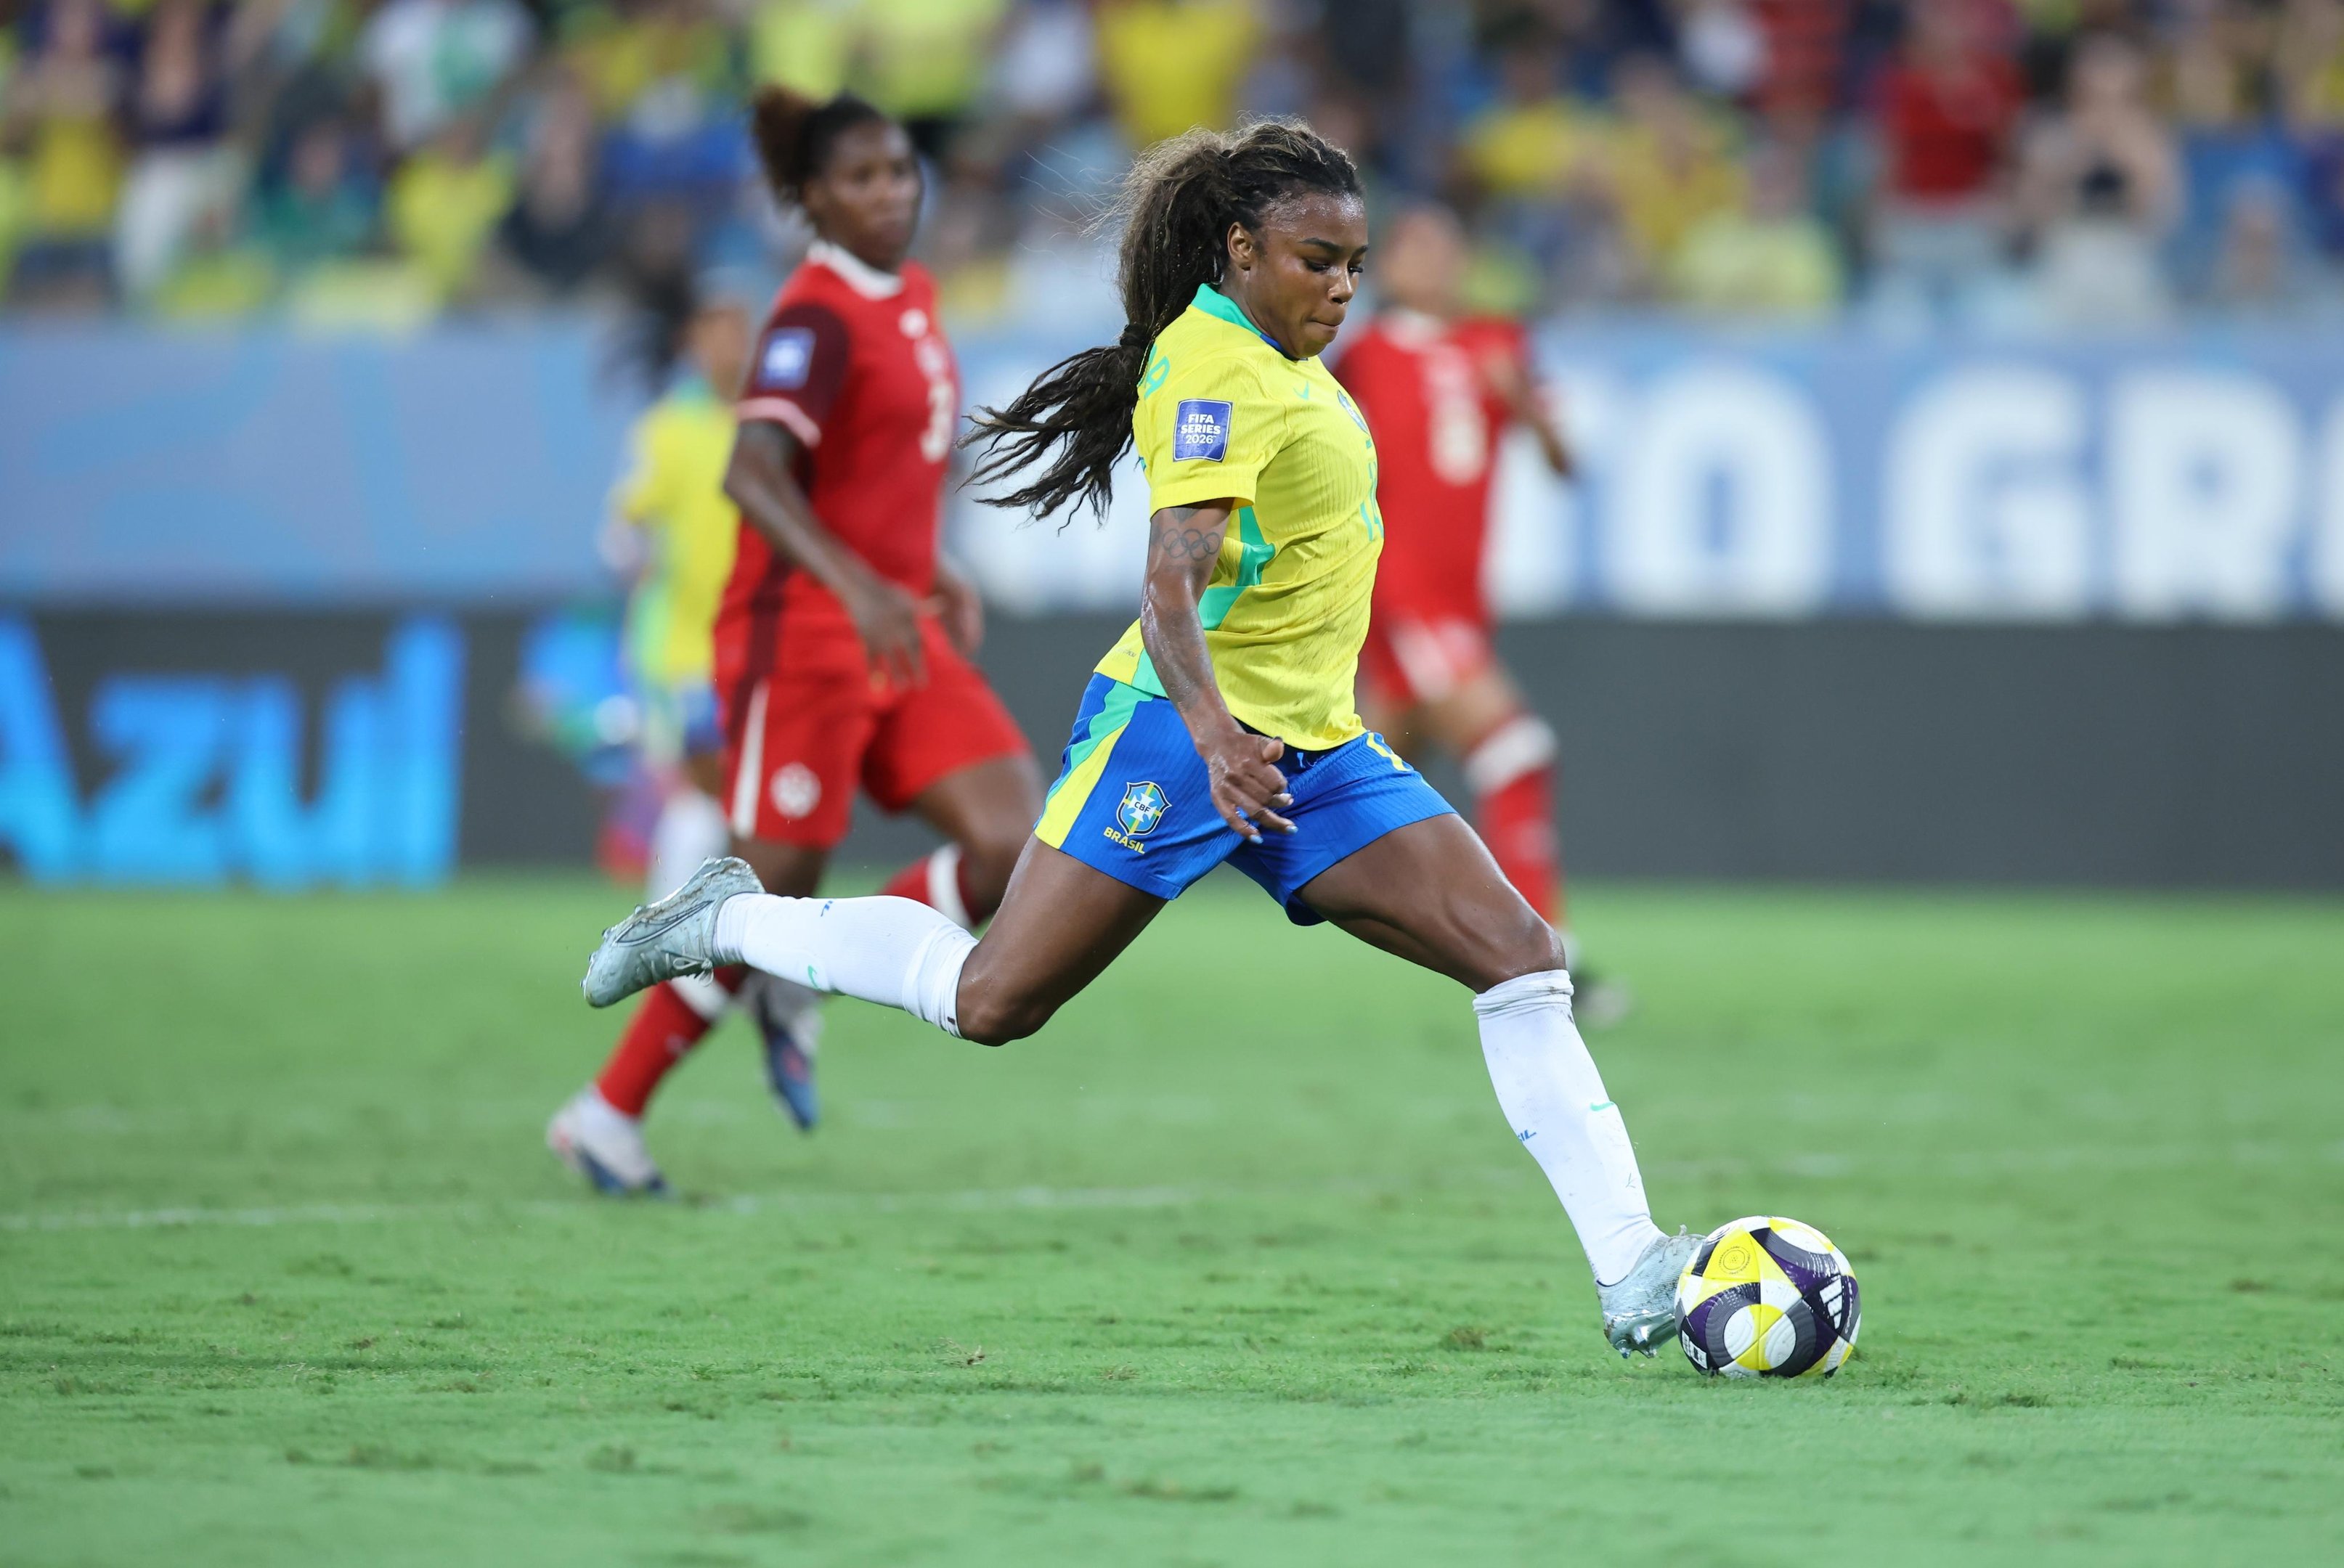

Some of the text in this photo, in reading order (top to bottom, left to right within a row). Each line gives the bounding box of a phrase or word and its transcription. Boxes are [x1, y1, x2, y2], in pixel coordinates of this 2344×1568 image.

[1188, 414, 1215, 424] FIFA
[1180, 424, 1221, 435] SERIES
[1889, 362, 2344, 621] GR
[1134, 801, 1151, 813] CBF
[1103, 826, 1146, 855] BRASIL
